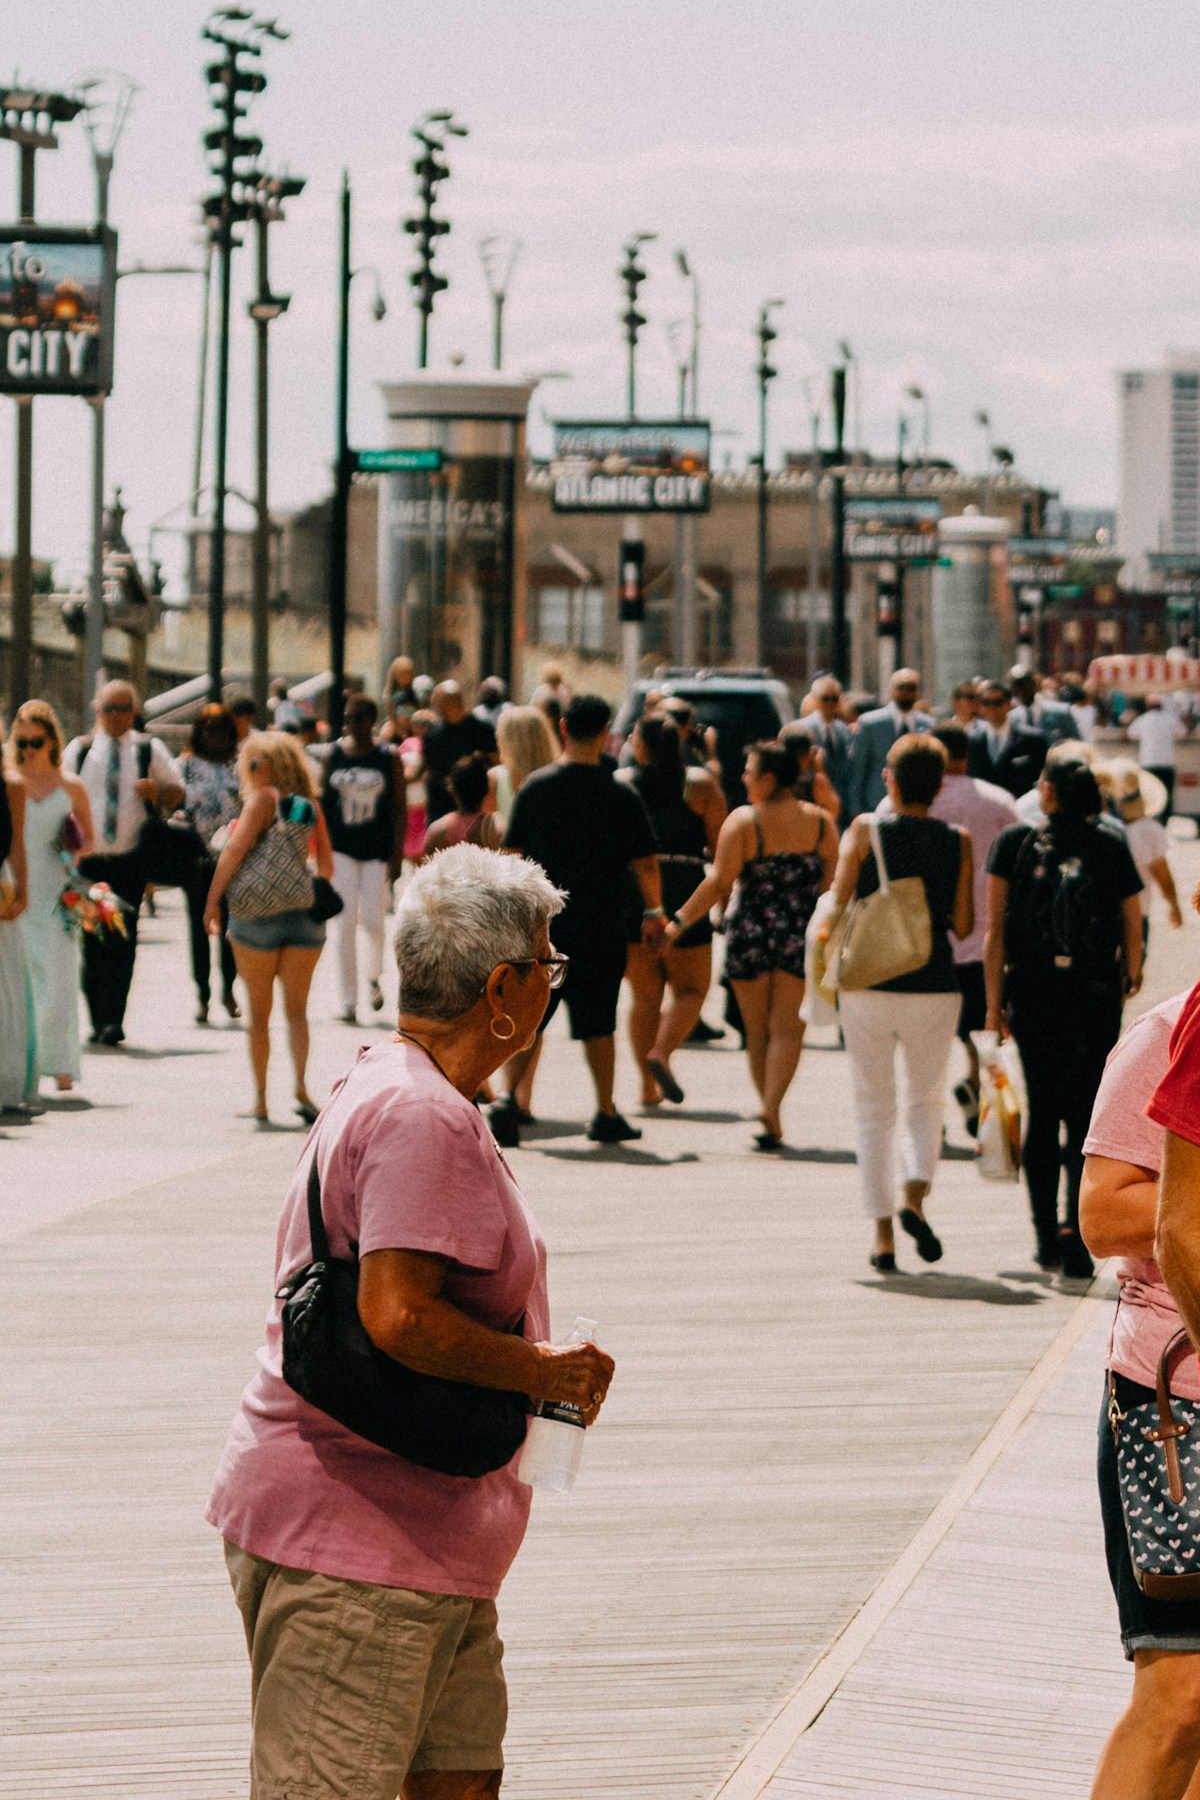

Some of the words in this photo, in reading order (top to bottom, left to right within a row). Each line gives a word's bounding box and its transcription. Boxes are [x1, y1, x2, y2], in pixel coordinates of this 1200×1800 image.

[10, 241, 46, 280] to
[7, 329, 87, 377] CITY
[554, 475, 650, 505] ATLANTIC
[654, 475, 702, 507] CITY
